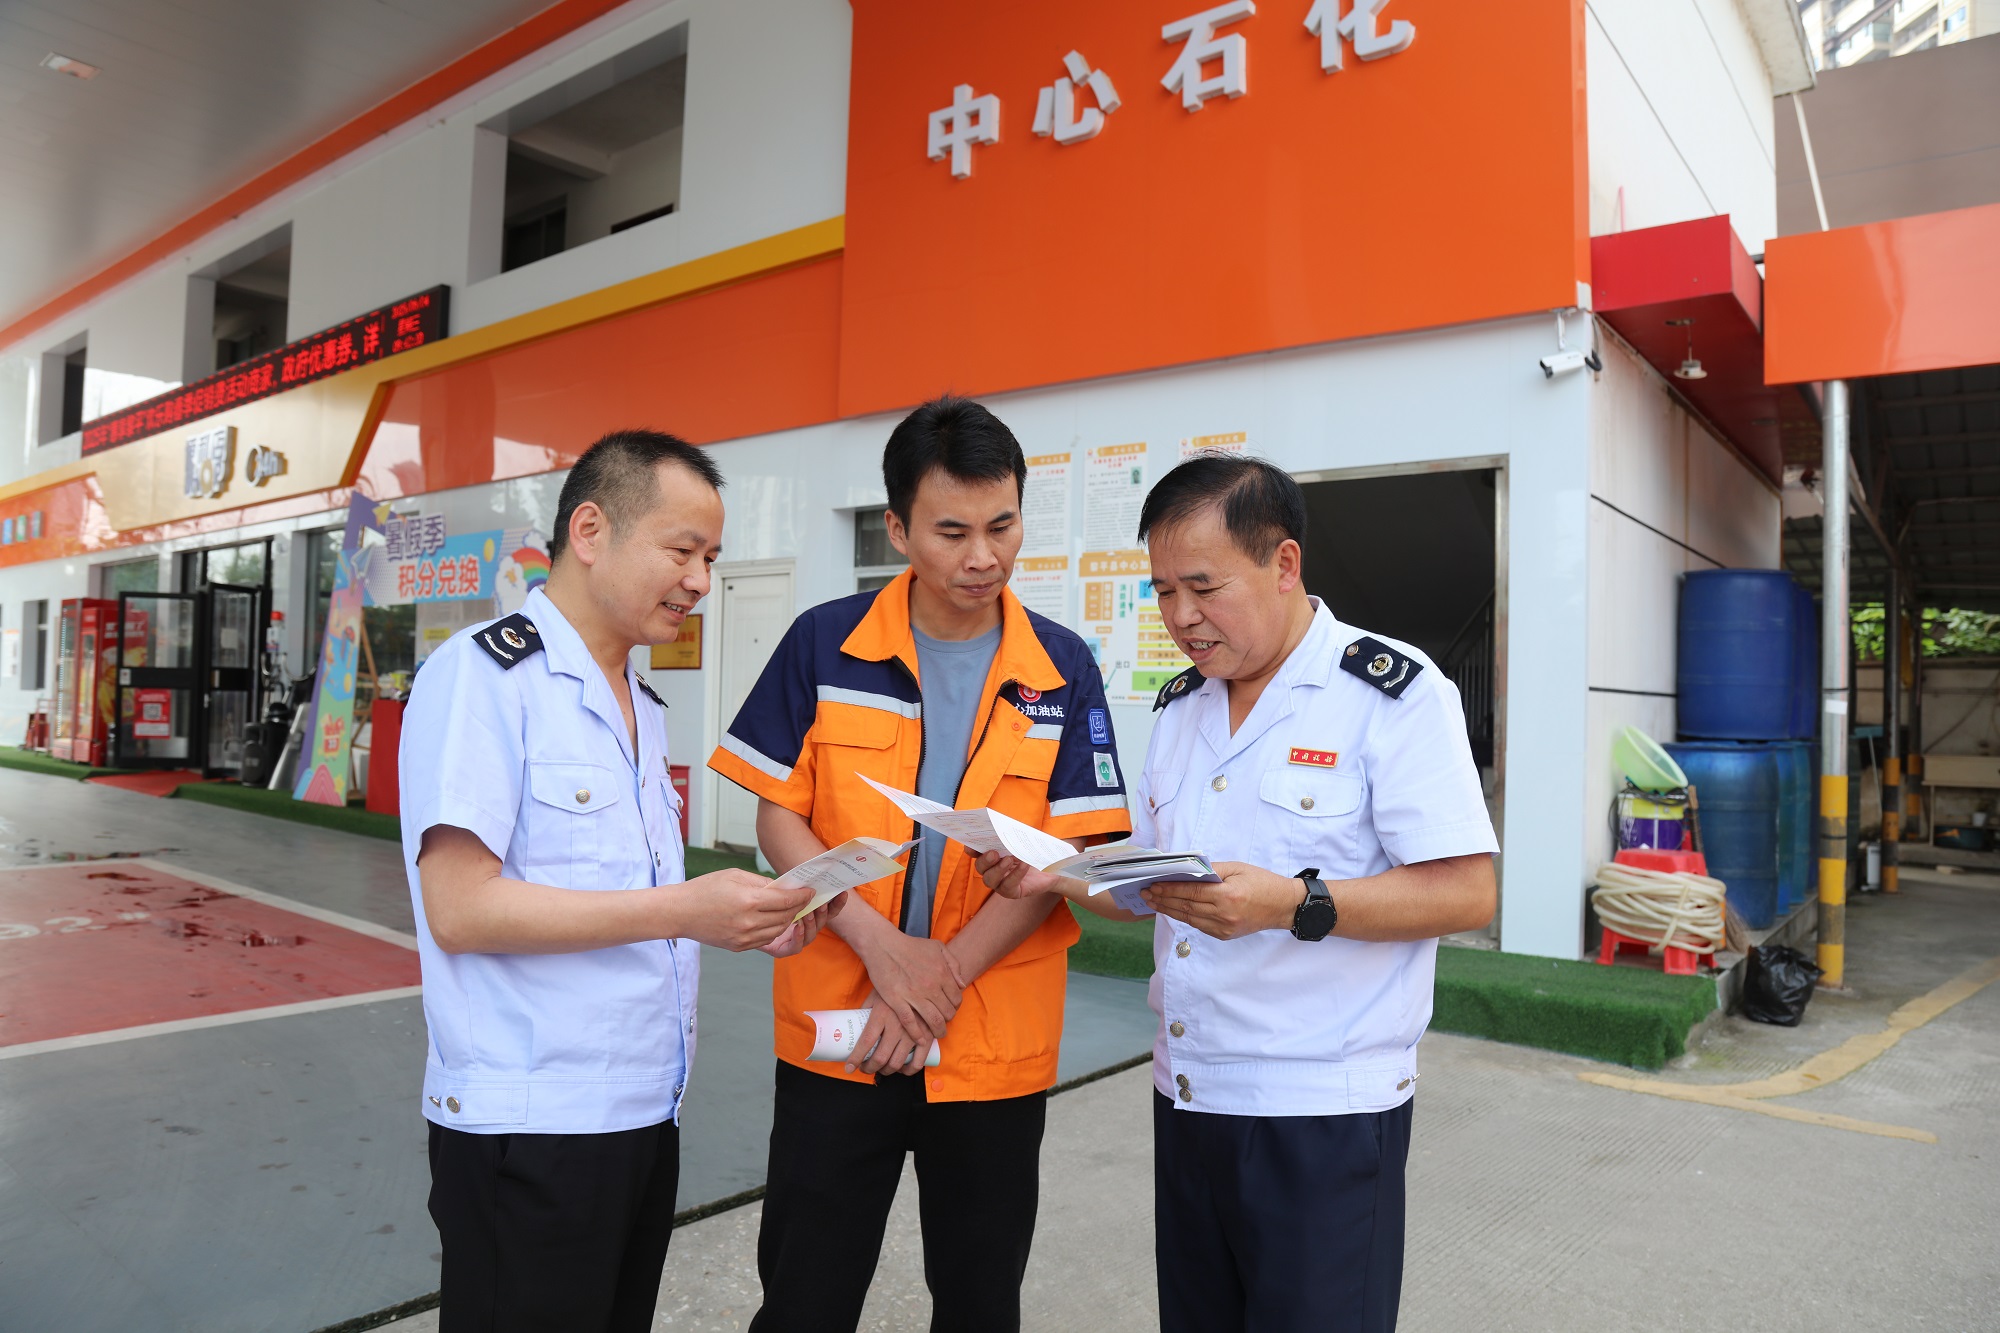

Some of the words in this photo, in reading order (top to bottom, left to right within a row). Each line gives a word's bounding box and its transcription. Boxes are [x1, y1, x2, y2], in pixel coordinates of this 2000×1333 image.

[927, 0, 1415, 178] 中心石化
[386, 514, 444, 561] 暑假季
[398, 556, 480, 598] 积分兑换
